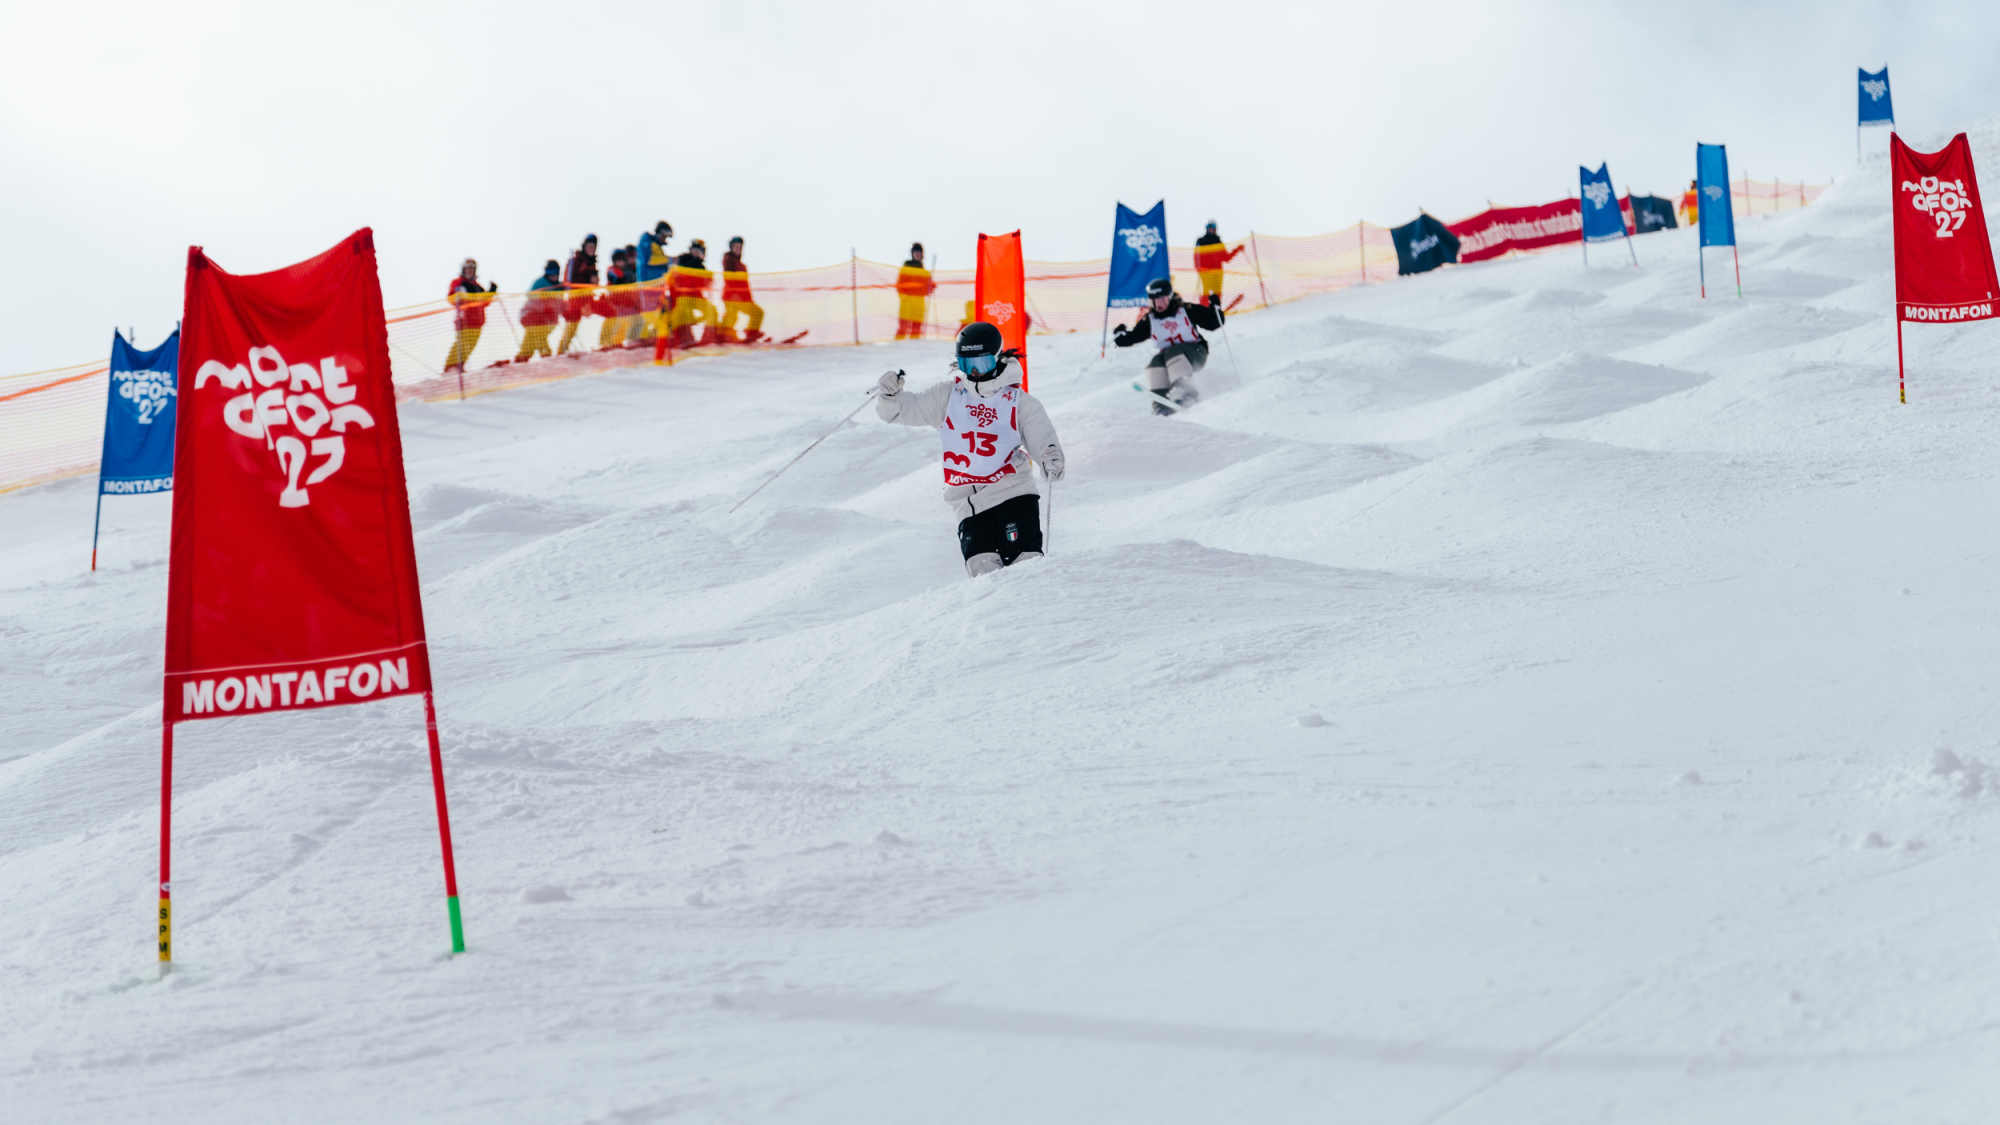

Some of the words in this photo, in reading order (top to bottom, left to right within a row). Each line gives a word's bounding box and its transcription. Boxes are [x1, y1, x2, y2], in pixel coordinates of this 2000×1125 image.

[1935, 210, 1967, 238] 27
[1904, 303, 1992, 321] MONTAFON
[138, 398, 169, 425] 27
[977, 417, 994, 428] 27
[961, 430, 999, 457] 13
[103, 476, 173, 494] MONTAFO
[275, 434, 346, 509] 27
[181, 657, 410, 715] MONTAFON
